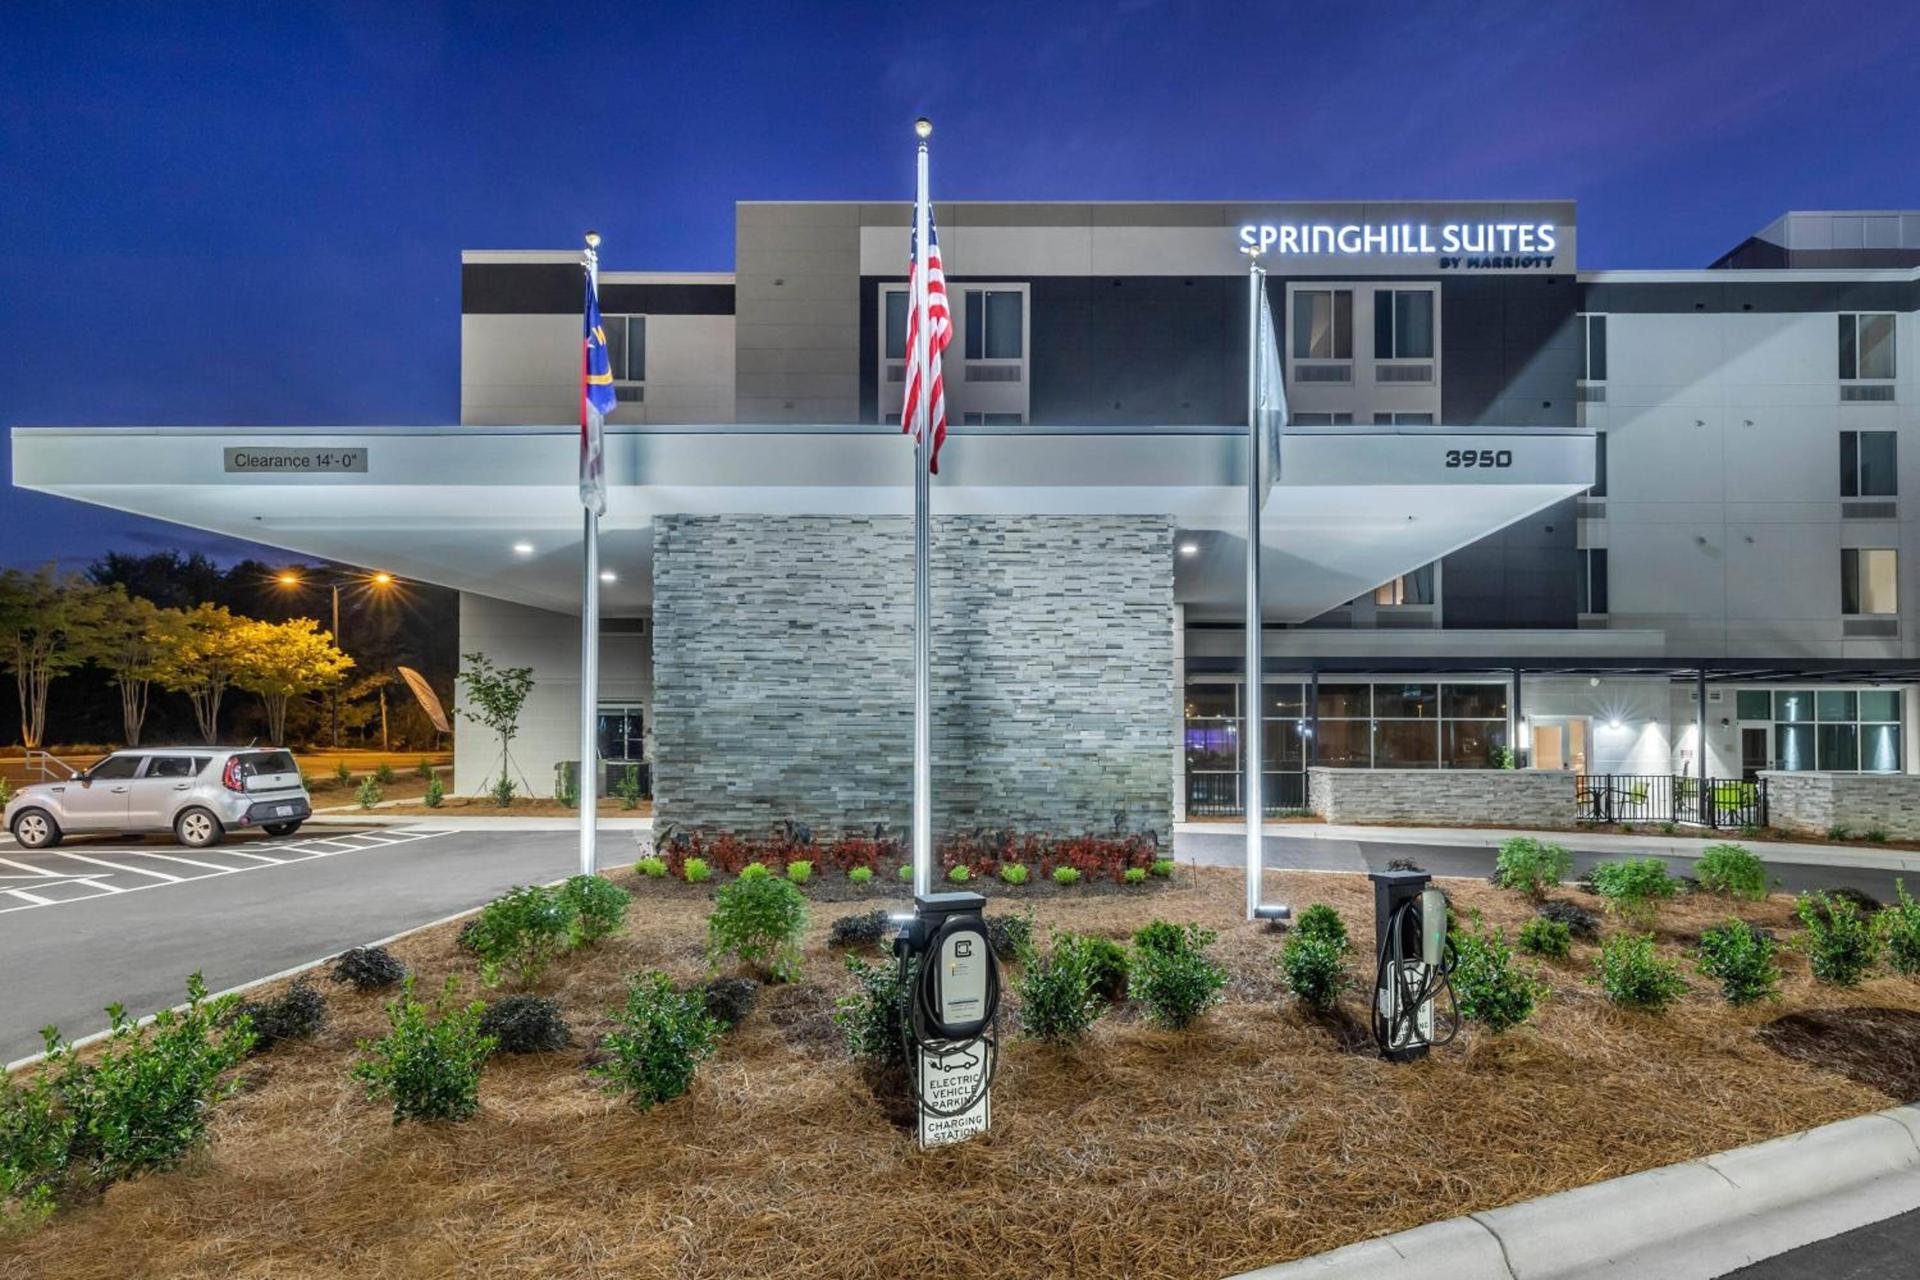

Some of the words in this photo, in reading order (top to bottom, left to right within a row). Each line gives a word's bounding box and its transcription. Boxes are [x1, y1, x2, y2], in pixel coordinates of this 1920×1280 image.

[1239, 224, 1436, 253] SPRINGHILL
[1441, 224, 1556, 253] SUITES
[1439, 256, 1462, 269] BY
[1466, 255, 1555, 269] MARRIOTT
[234, 453, 310, 468] Clearance
[1445, 449, 1512, 468] 3950
[930, 1073, 979, 1089] ELECTRIC
[932, 1084, 978, 1099] VEHICLE
[928, 1115, 983, 1132] CHARGING
[934, 1126, 978, 1141] STATION
